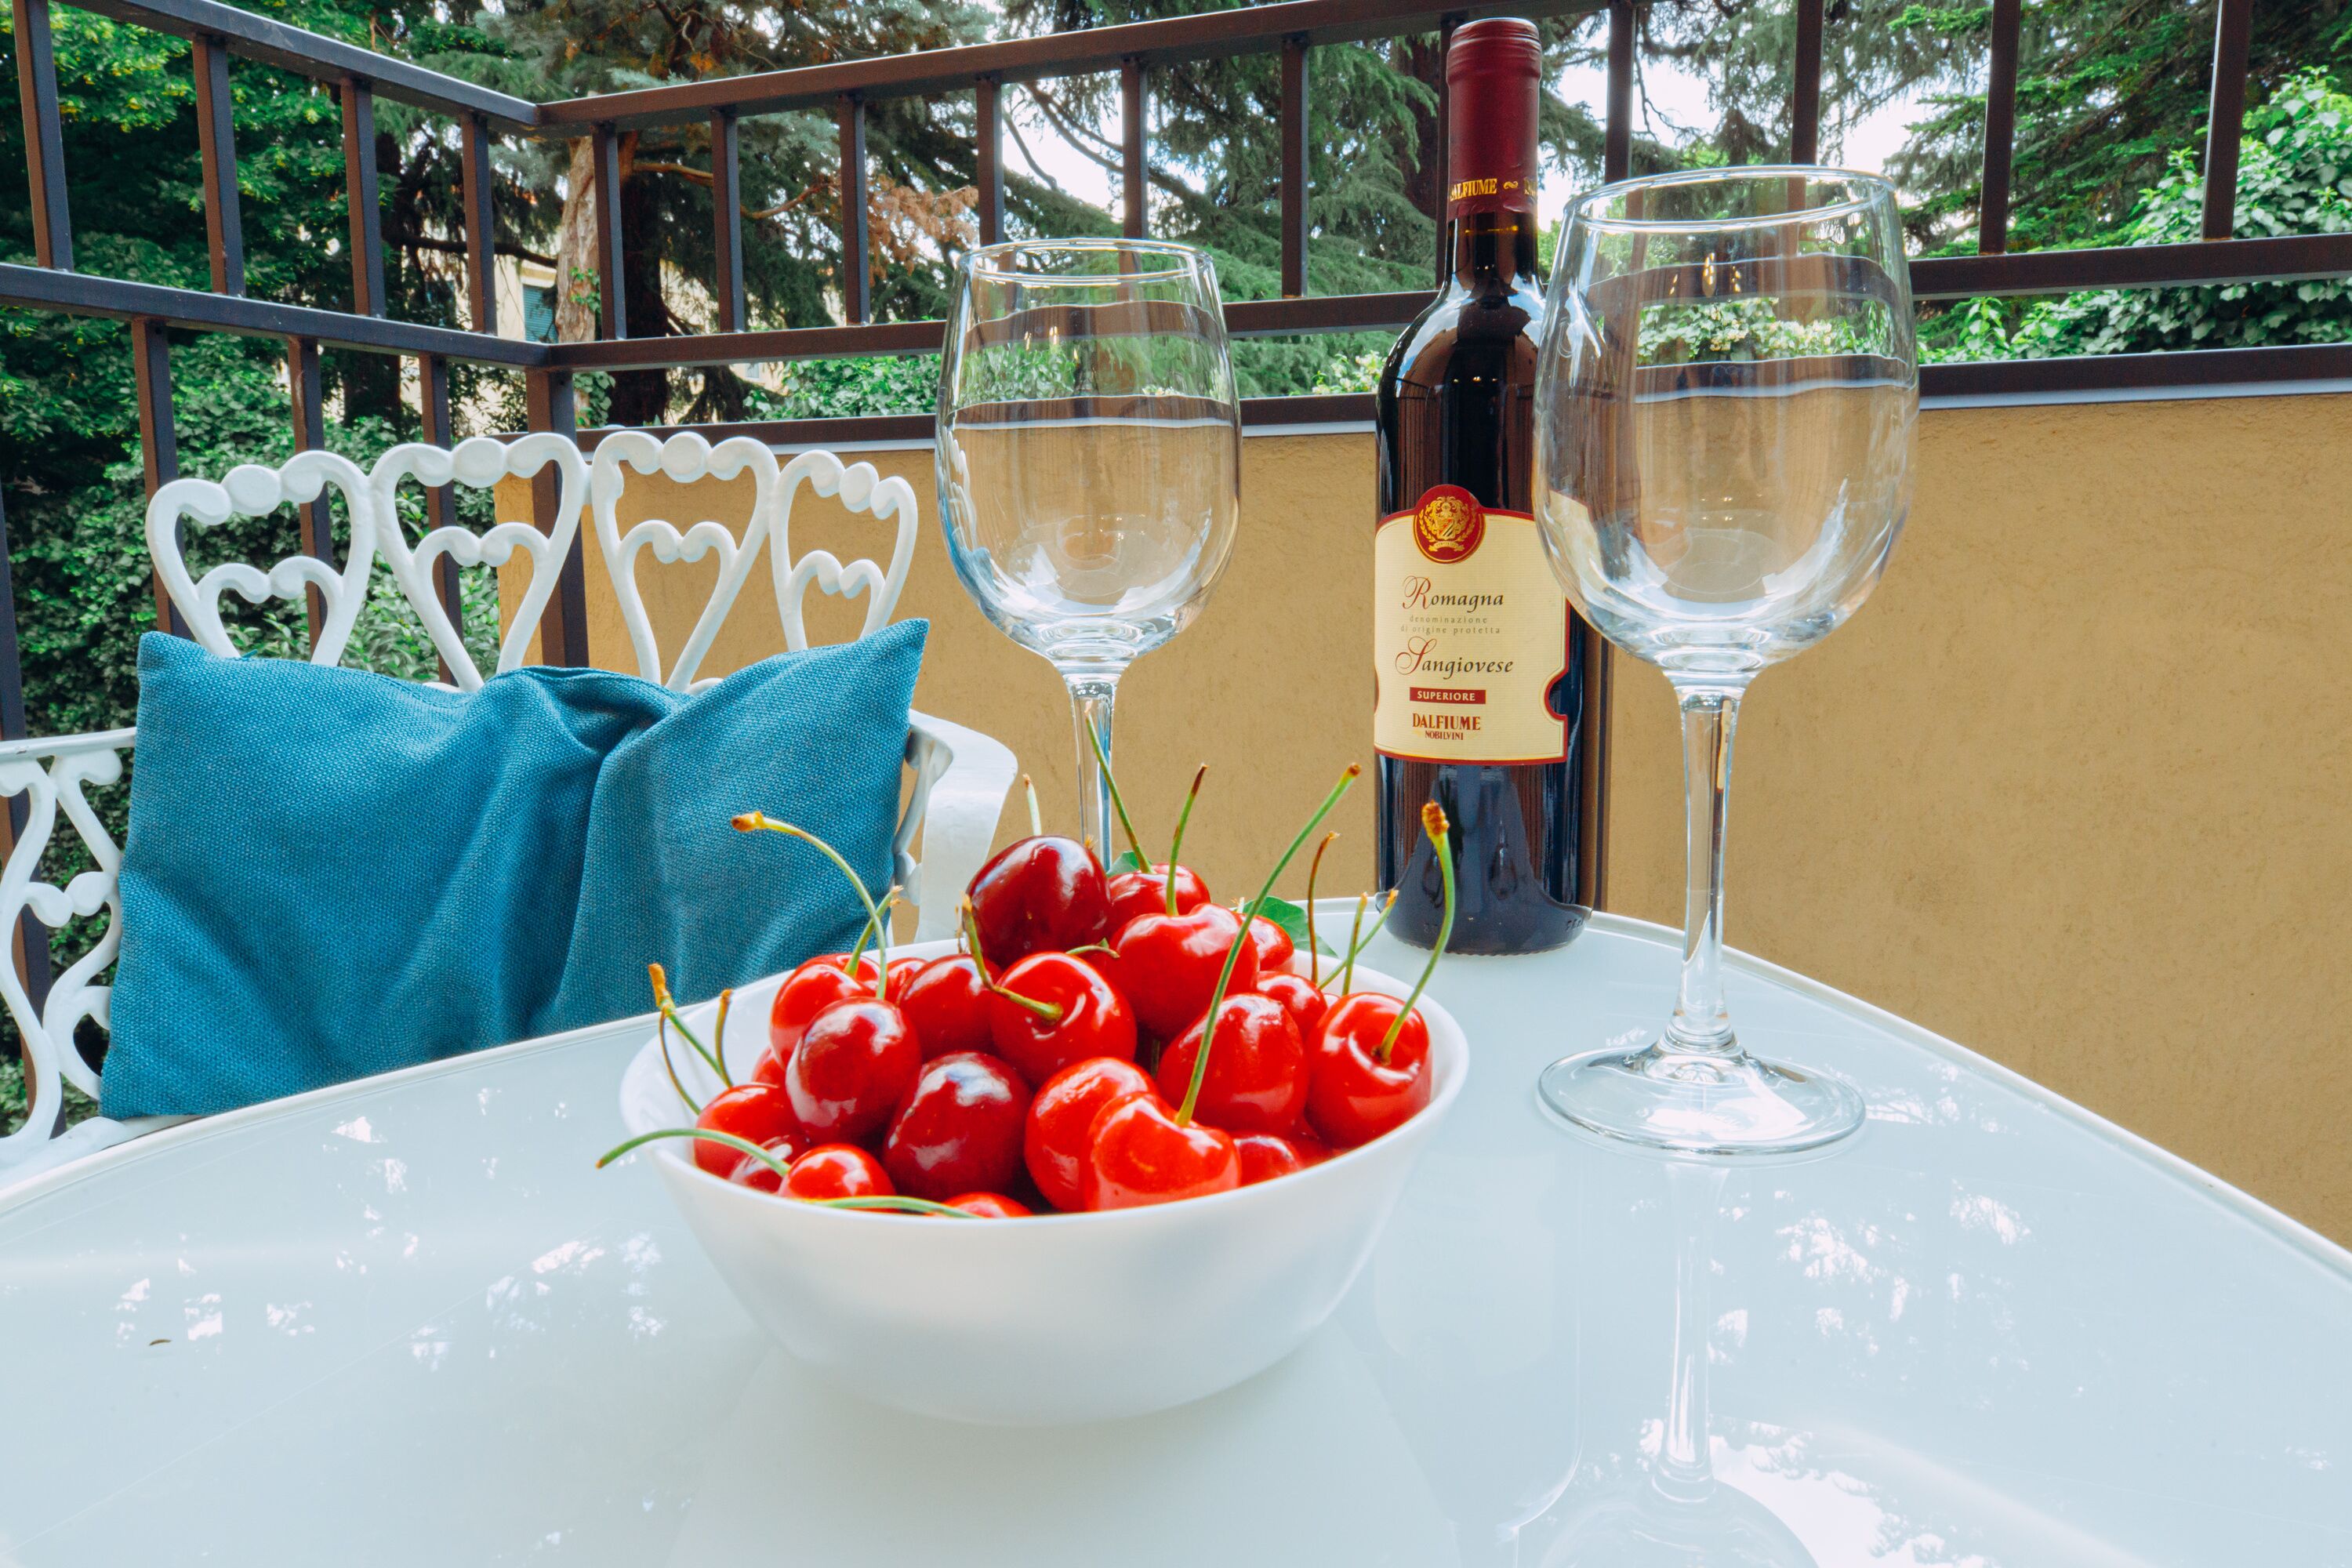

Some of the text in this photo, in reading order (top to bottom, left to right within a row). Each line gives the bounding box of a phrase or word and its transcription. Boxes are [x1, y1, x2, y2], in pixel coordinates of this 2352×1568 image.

[1402, 575, 1504, 613] Romagna
[1410, 615, 1487, 624] denominazione
[1412, 626, 1446, 635] origine
[1454, 626, 1500, 636] protetta
[1395, 636, 1513, 680] Sangiovese
[1417, 691, 1475, 702] SUPERIORE
[1412, 713, 1481, 731] DALFIUME
